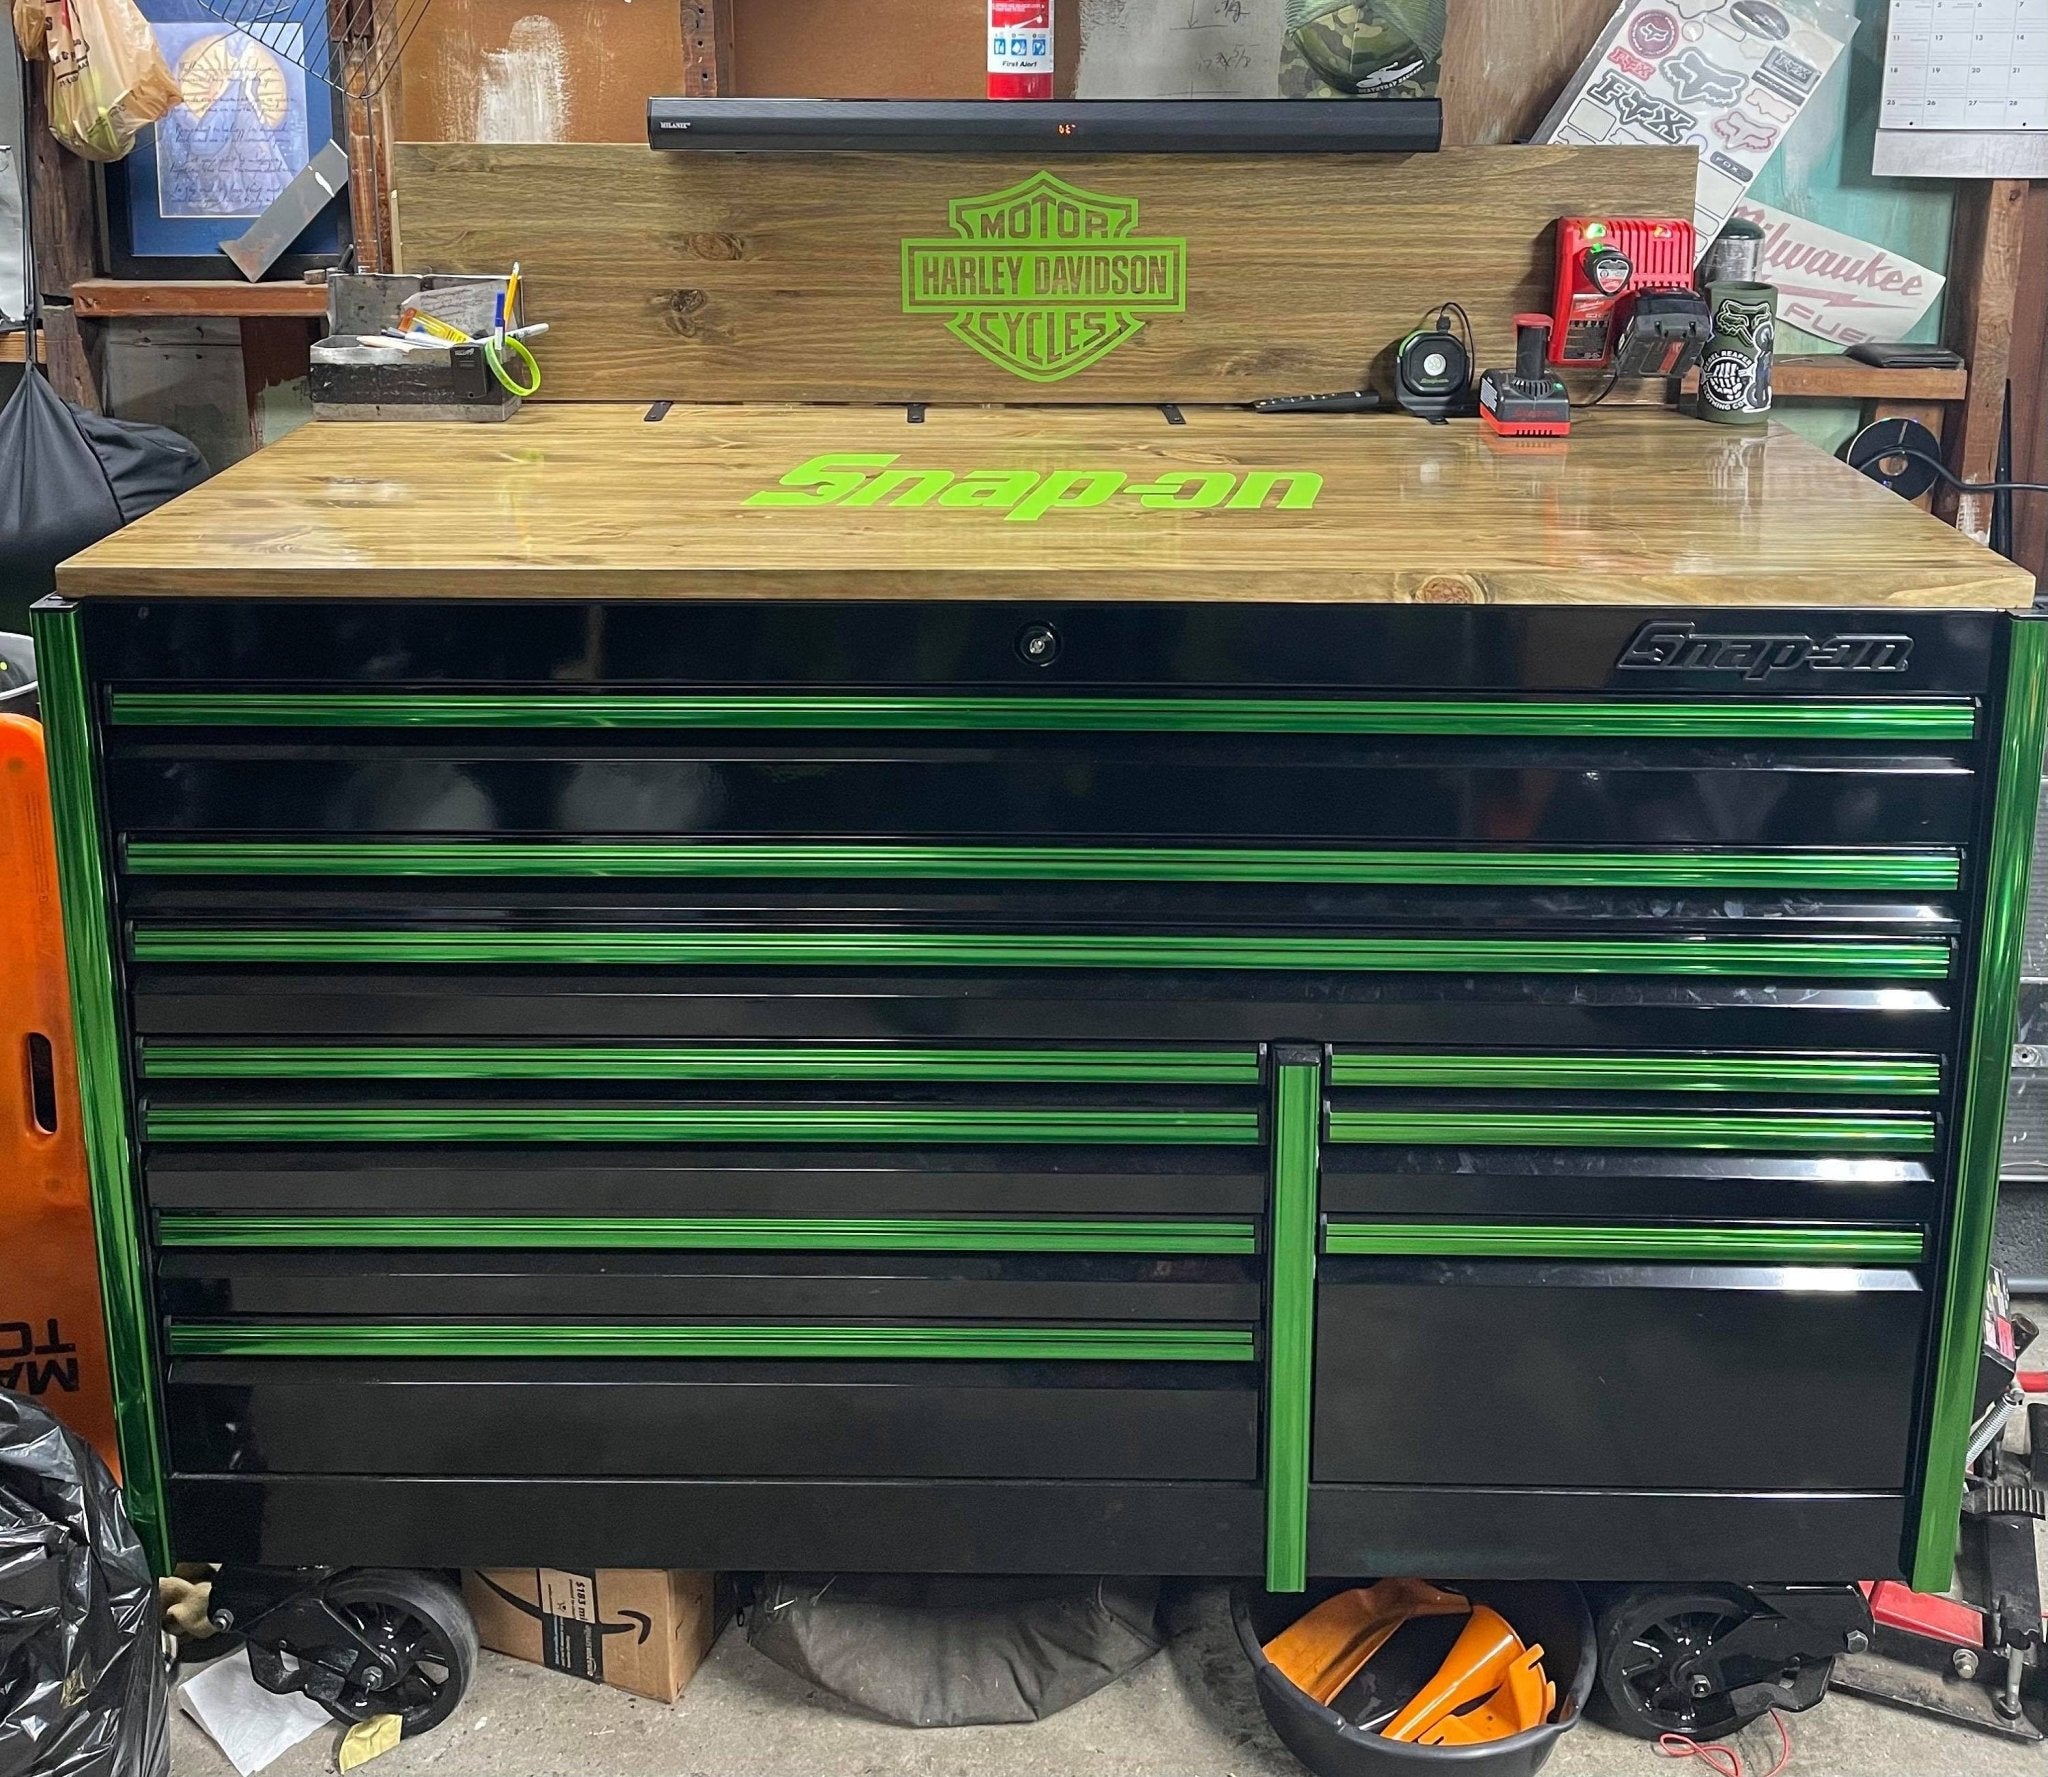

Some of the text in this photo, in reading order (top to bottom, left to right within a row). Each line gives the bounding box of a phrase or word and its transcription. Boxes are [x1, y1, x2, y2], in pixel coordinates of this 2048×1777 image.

[1002, 60, 1038, 68] First Alert
[1587, 69, 1697, 144] FOX
[980, 193, 1109, 240] MOTOR
[921, 254, 1167, 296] HARLEY DAVIDSON
[1731, 205, 1923, 296] Mlwaukee
[978, 311, 1107, 366] CYCLES
[1720, 350, 1753, 367] REAPER
[740, 452, 1324, 521] Snap-on
[1616, 620, 1915, 681] Snap-on
